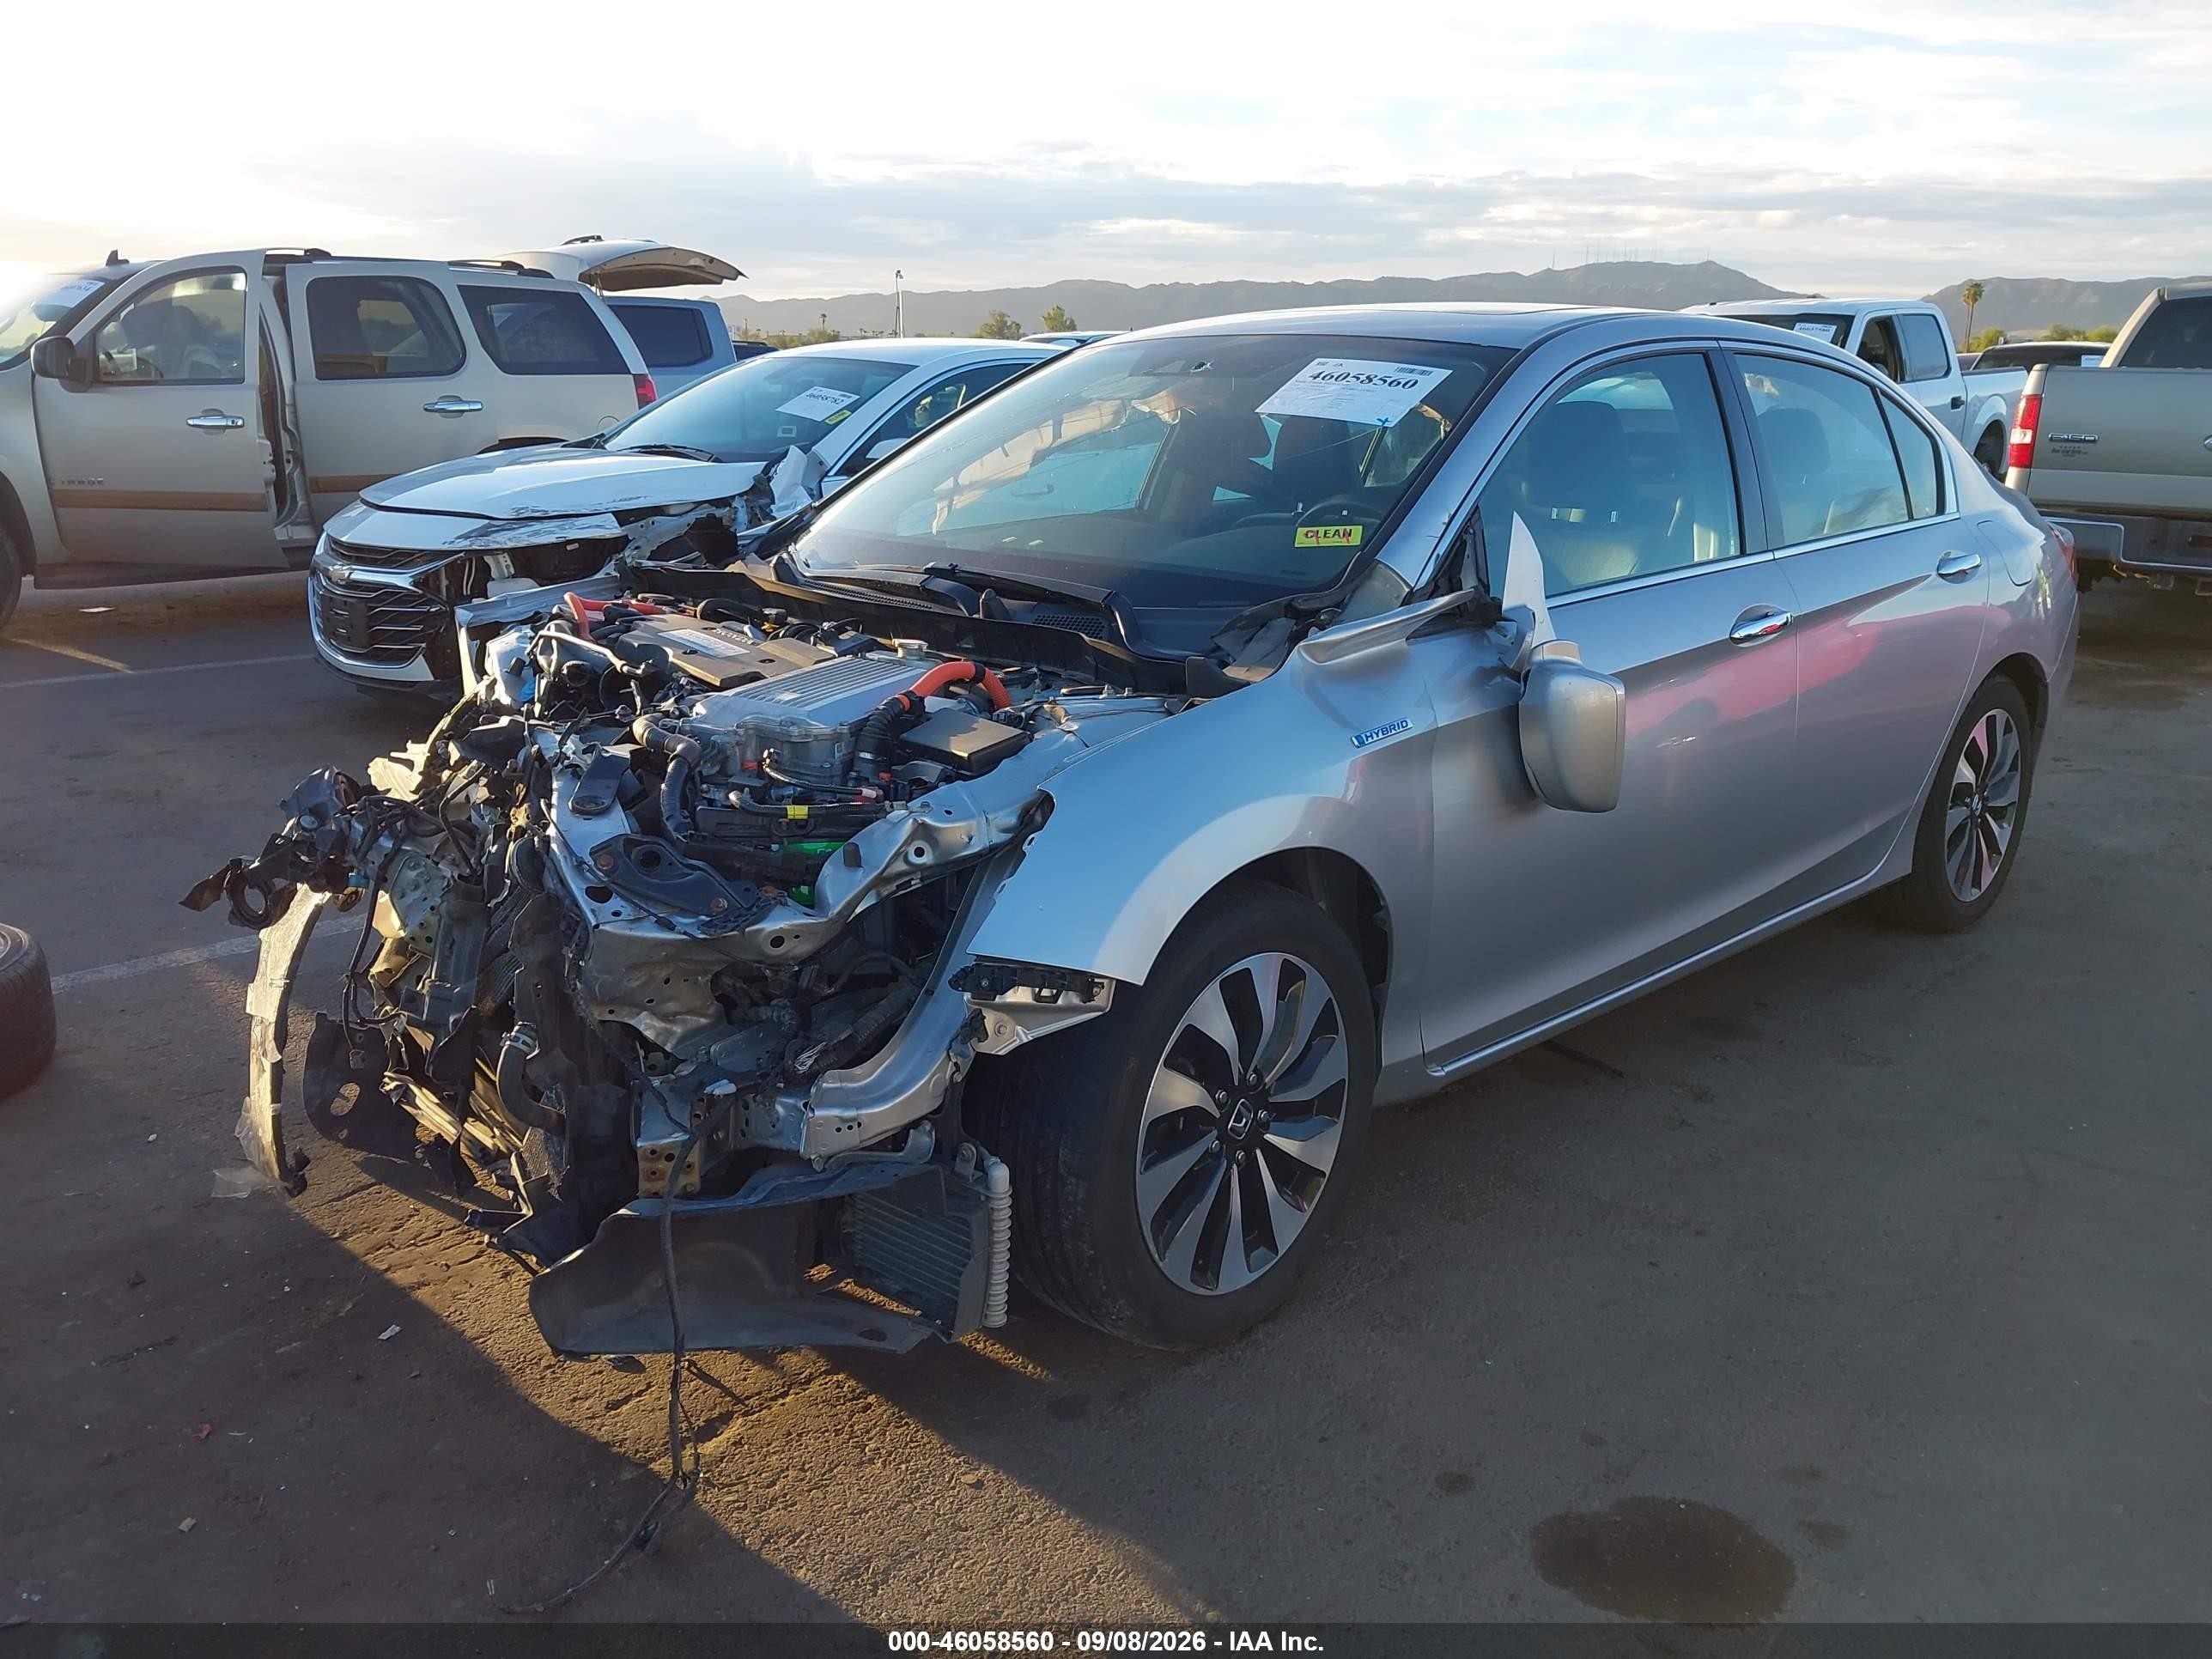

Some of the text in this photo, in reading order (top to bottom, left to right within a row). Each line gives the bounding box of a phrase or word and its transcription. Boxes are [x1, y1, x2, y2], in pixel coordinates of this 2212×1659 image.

[1309, 370, 1419, 389] 46058560
[1304, 527, 1352, 539] CLEAN
[1364, 720, 1408, 742] HYBRID
